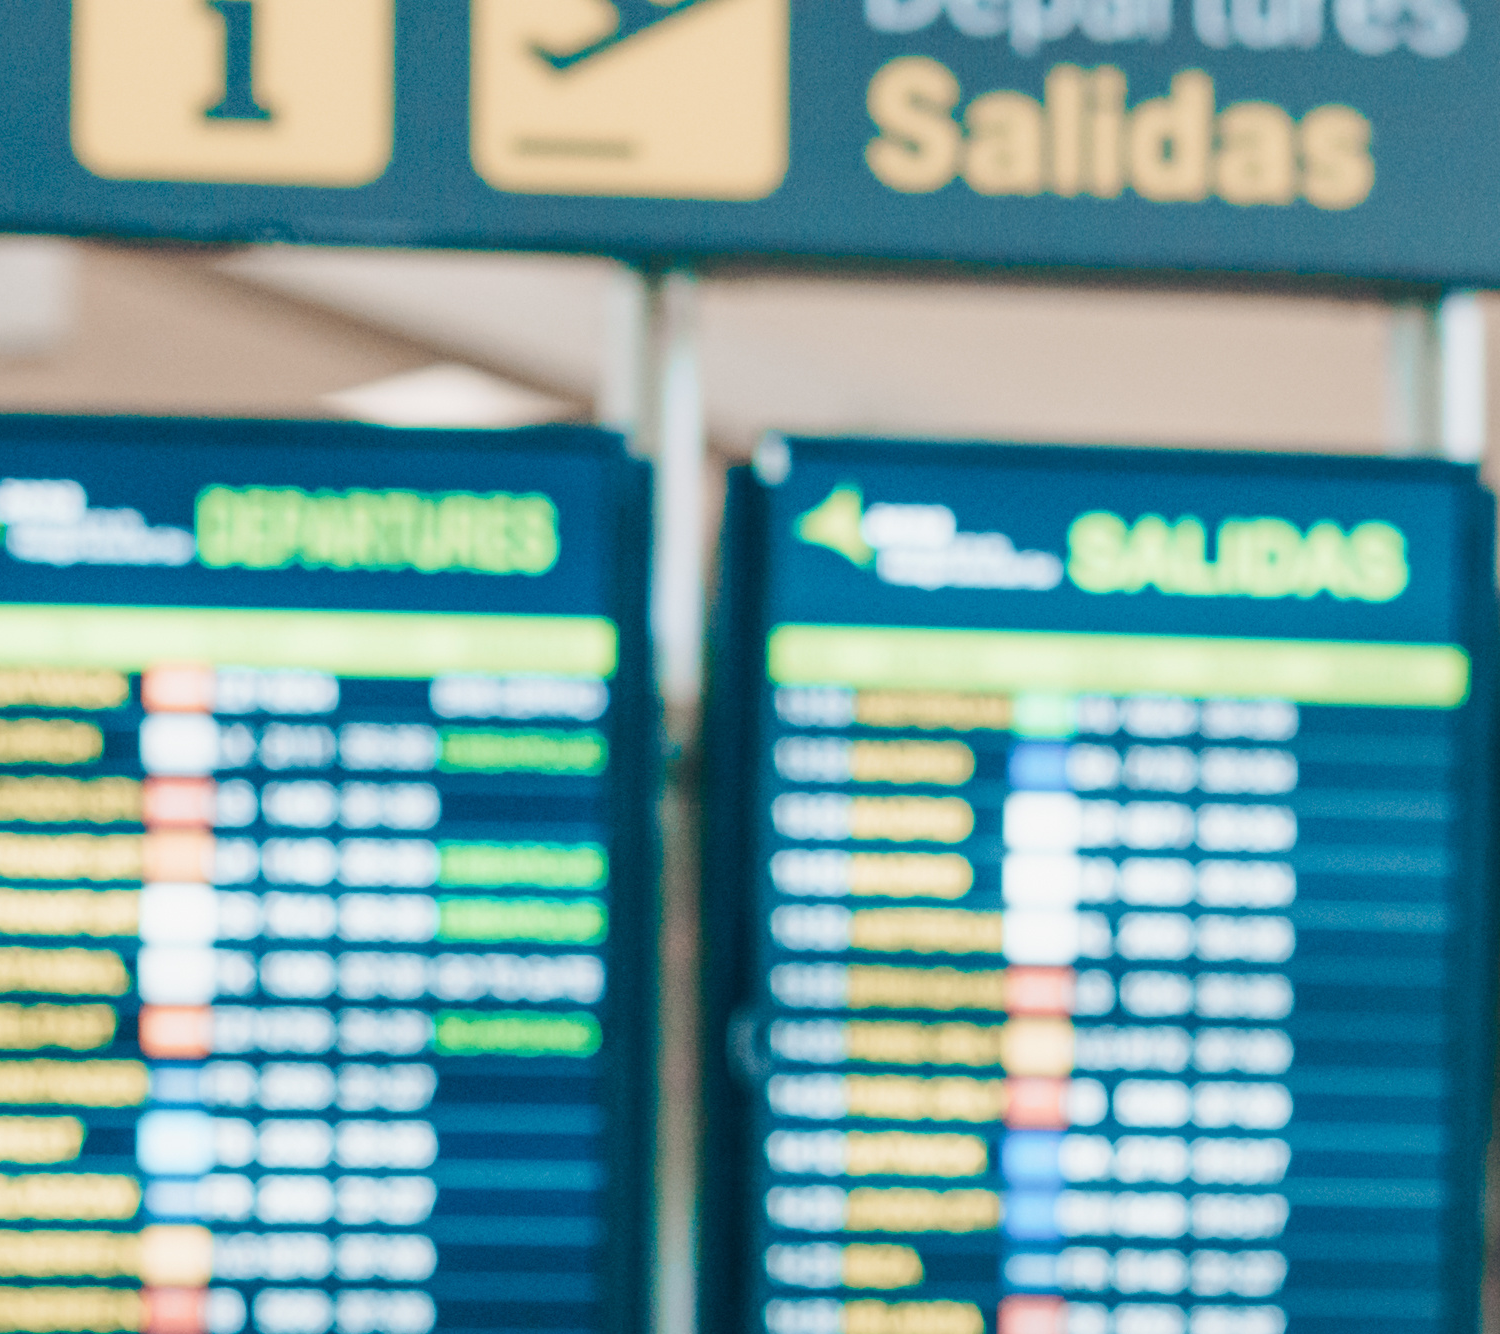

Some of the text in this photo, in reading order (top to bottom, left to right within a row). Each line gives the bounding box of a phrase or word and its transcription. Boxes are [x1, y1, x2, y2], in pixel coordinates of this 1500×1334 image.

[865, 55, 1375, 211] Salidas
[194, 483, 560, 577] DEPARTURES
[1067, 510, 1410, 602] SALIDAS
